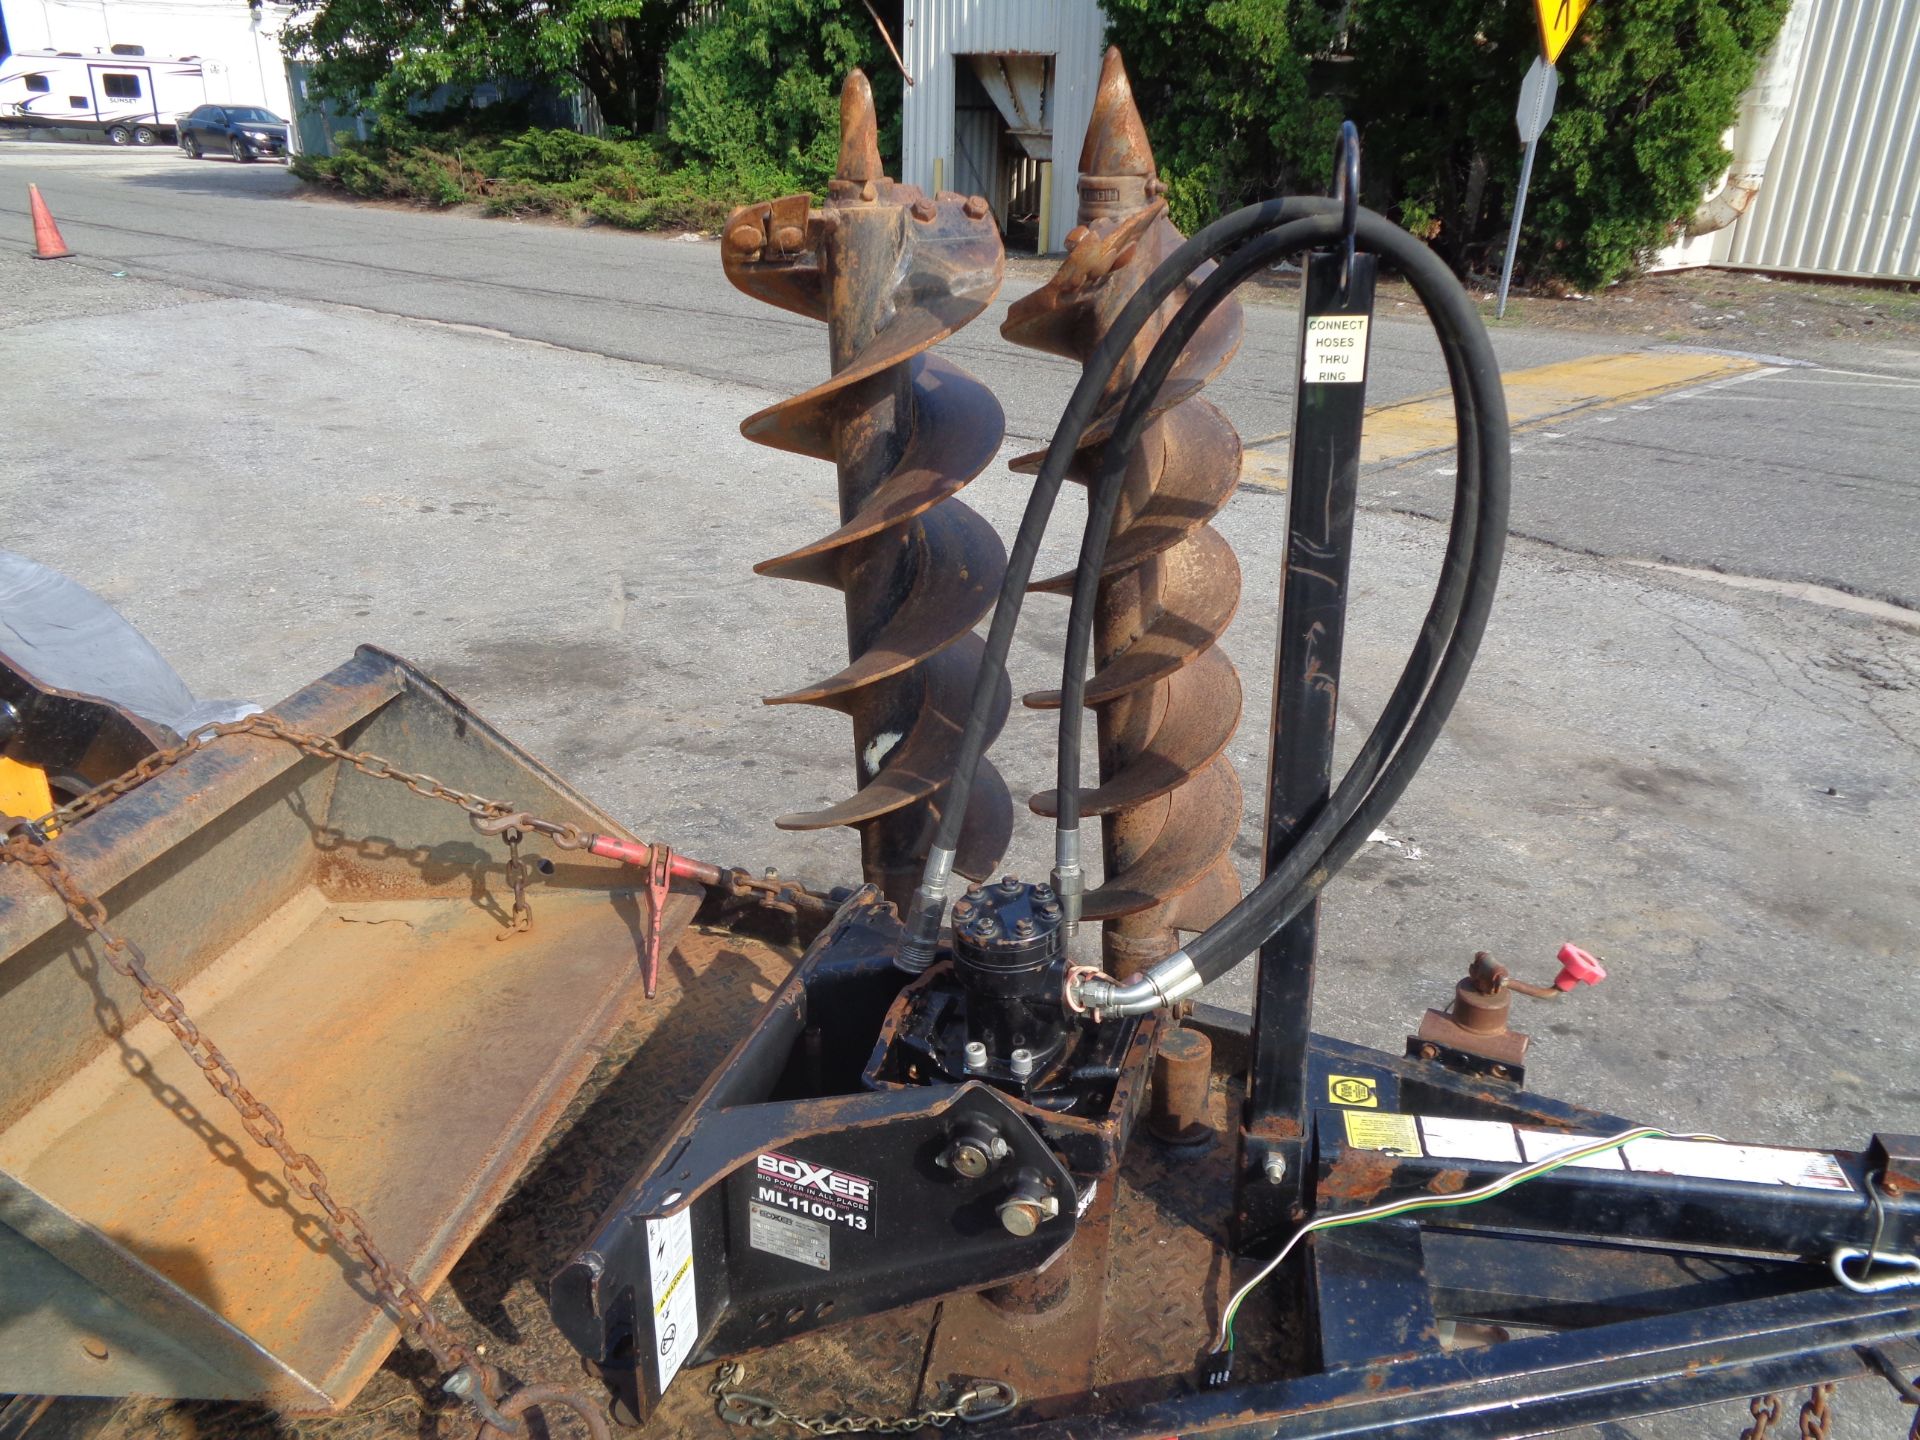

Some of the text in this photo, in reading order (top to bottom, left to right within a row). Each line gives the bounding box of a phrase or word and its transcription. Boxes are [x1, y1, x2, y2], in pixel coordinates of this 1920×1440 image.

[1309, 320, 1364, 331] CONNECT
[1316, 337, 1354, 348] HOSES
[1319, 354, 1349, 364] THRU
[1319, 371, 1346, 381] RING
[757, 1154, 869, 1200] BOXER
[757, 1173, 869, 1212] BIG POWER IN ALL PLACES
[759, 1186, 868, 1231] ML1100-13
[665, 1262, 689, 1299] WARNING
